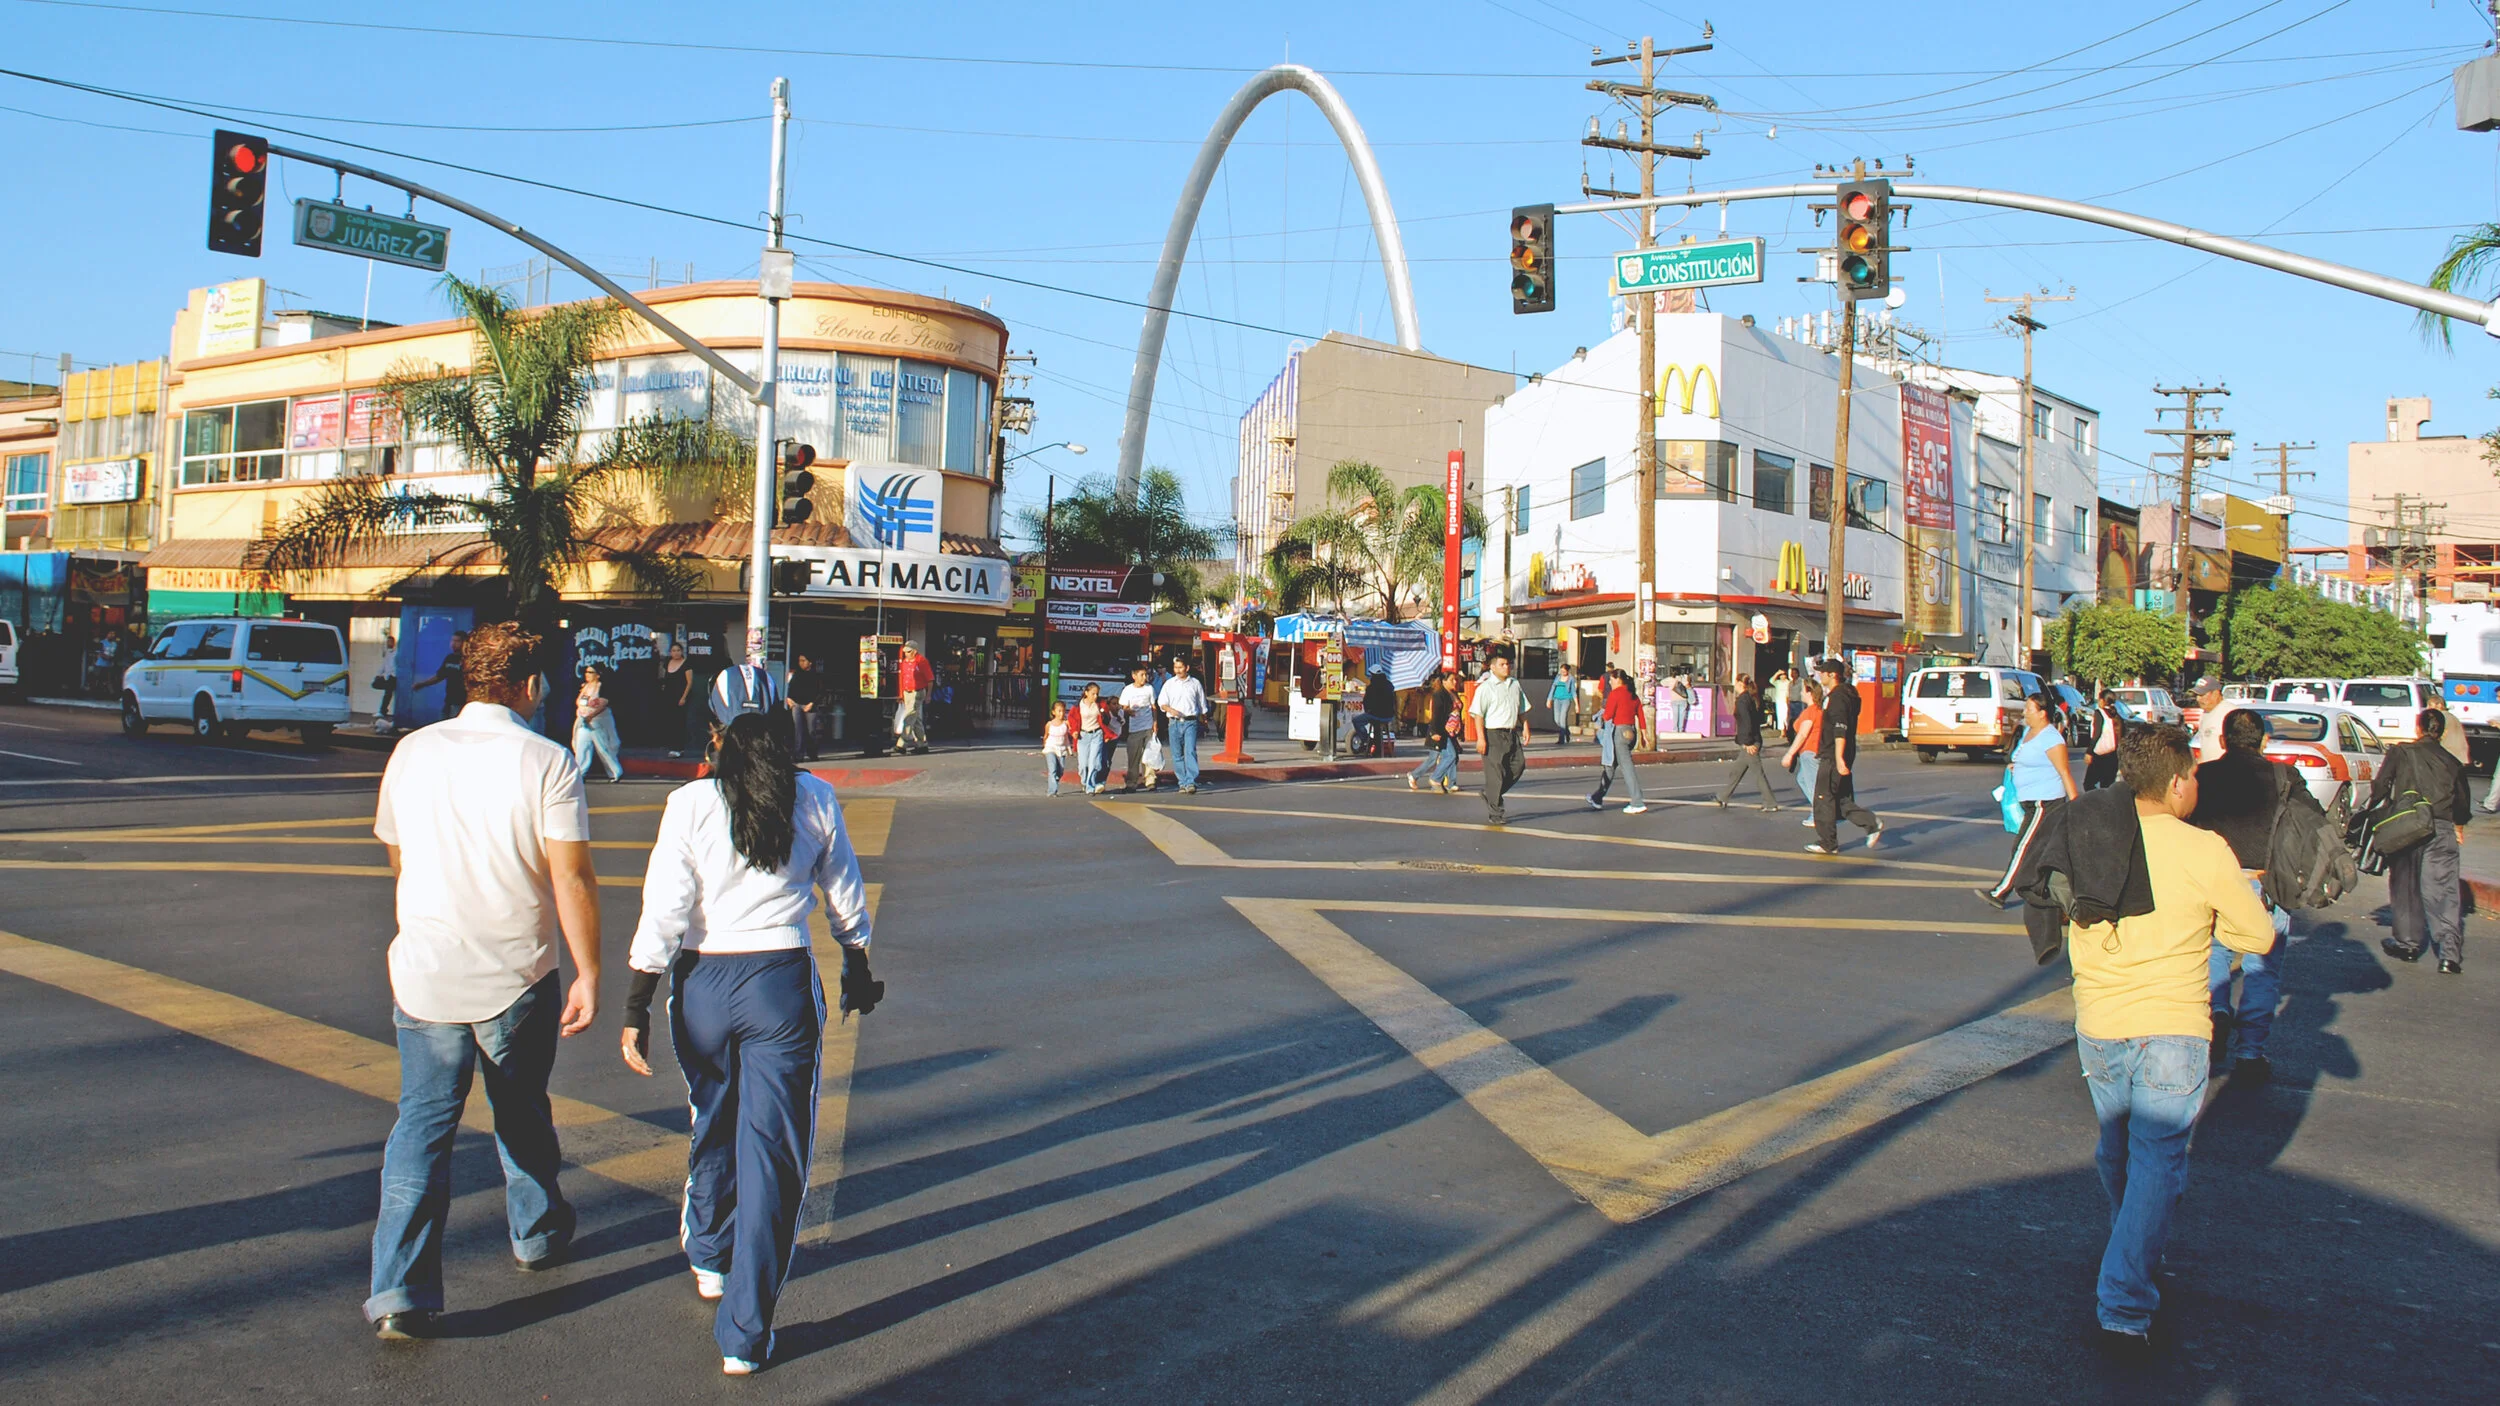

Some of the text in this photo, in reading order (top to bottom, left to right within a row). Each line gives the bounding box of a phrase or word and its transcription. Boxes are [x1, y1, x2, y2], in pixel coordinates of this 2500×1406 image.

[337, 226, 413, 257] JUÁREZ
[413, 229, 435, 261] 2
[1650, 252, 1753, 284] CONSTITUCIÓN
[872, 306, 929, 324] EDIFICIO
[813, 314, 966, 355] Gloria de Stewart
[776, 365, 850, 385] IRUJANO
[1447, 461, 1460, 535] Emergencia
[805, 558, 990, 595] FARMACIA
[1051, 576, 1118, 593] NEXTEL
